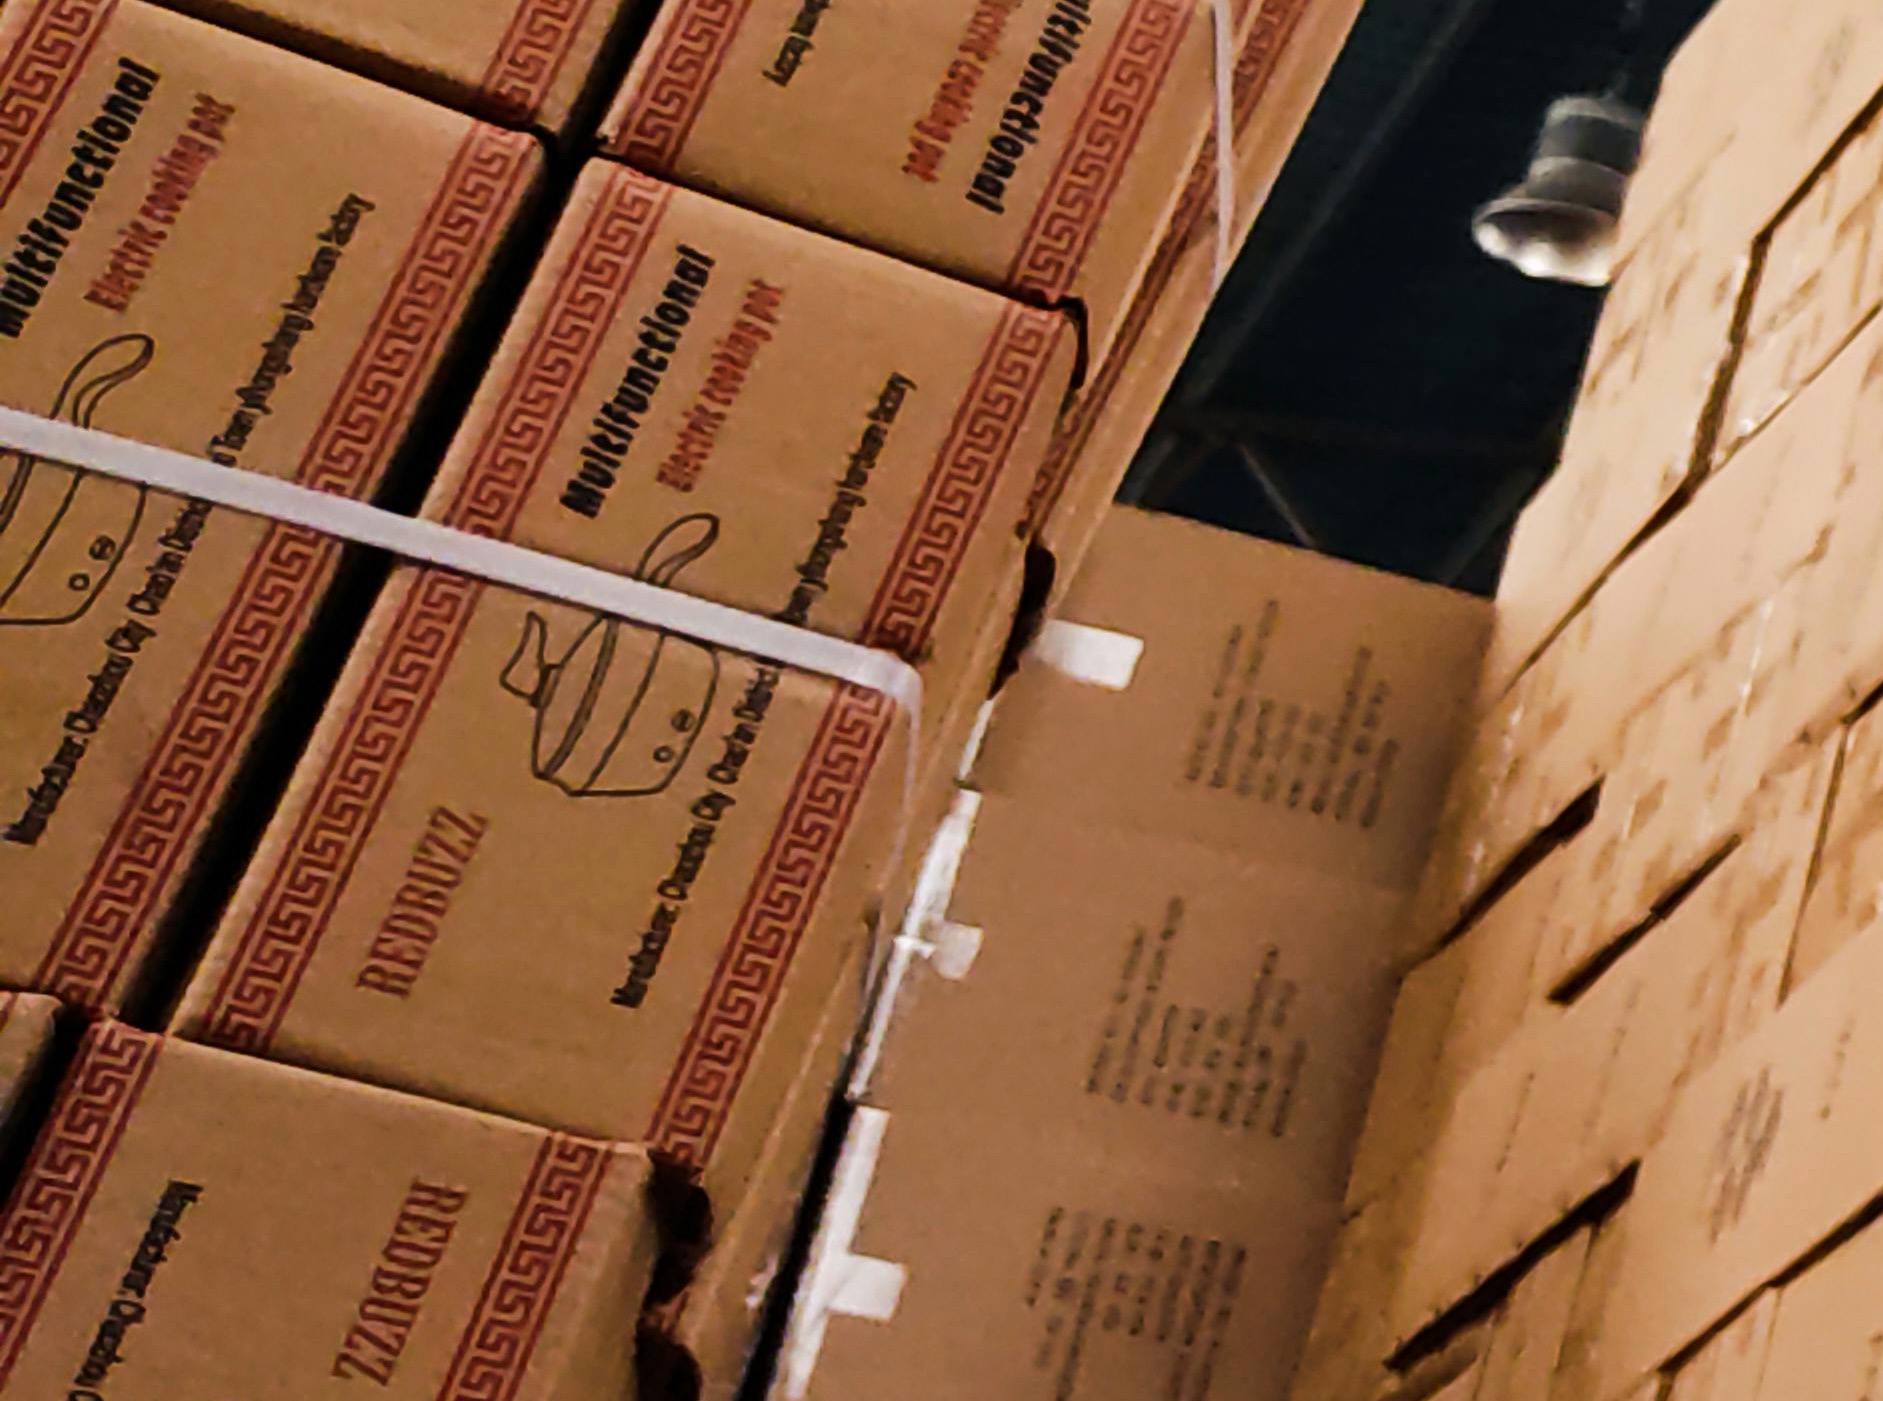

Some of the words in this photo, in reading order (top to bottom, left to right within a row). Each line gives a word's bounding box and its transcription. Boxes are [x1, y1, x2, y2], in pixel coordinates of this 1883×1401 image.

[559, 245, 714, 519] Multifunctional
[355, 807, 487, 999] REDBUZZ
[332, 1180, 468, 1386] REDBUZZ
